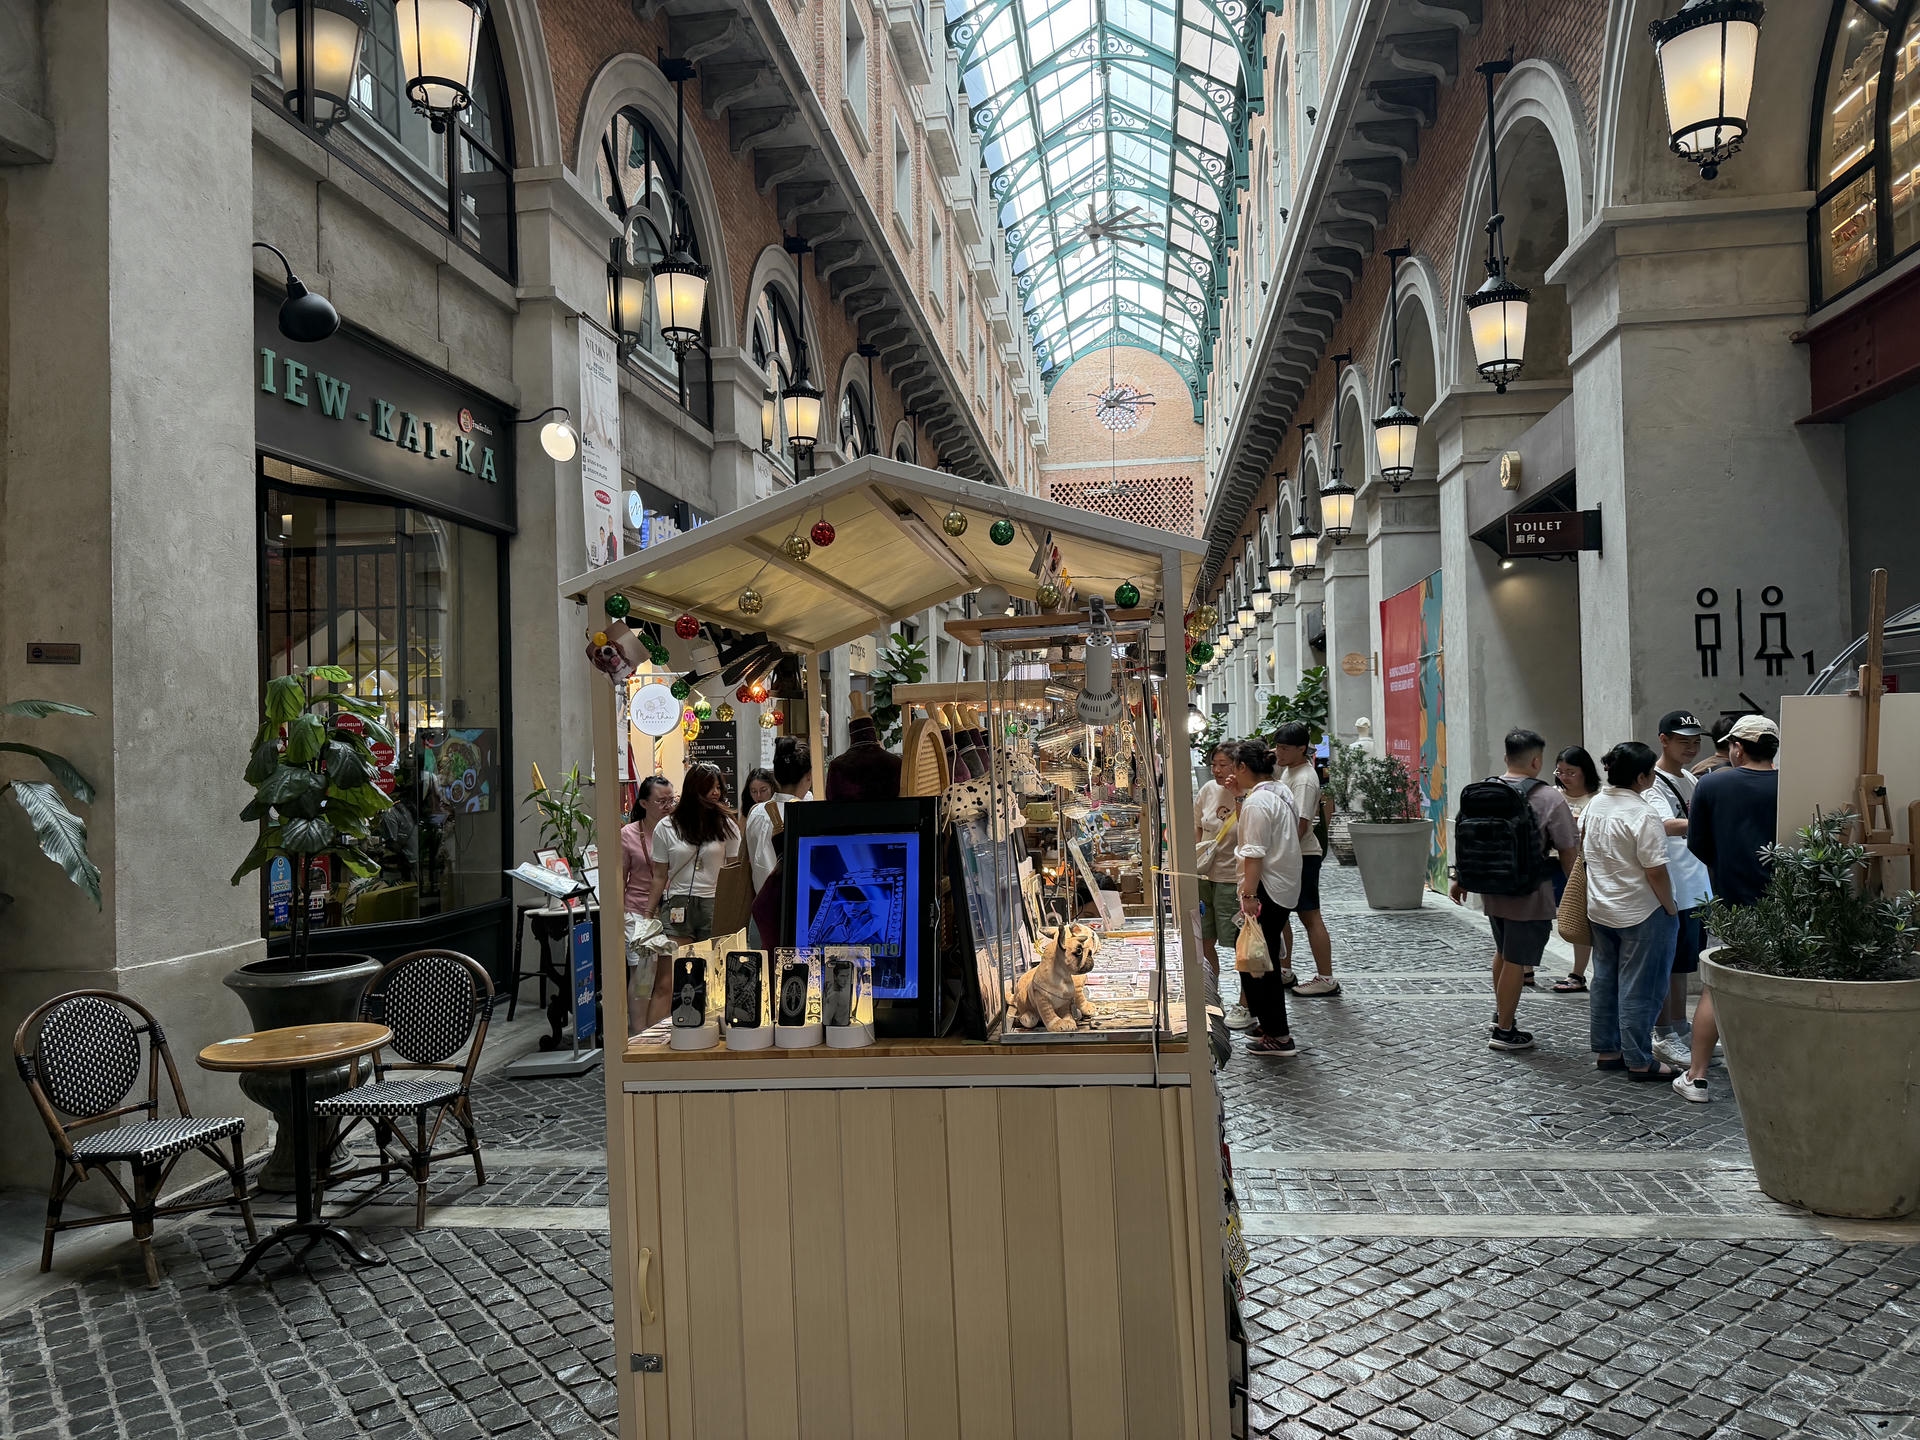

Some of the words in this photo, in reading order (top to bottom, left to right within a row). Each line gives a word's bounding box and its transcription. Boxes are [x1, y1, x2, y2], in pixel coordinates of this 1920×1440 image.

[582, 432, 588, 446] 4
[1514, 520, 1562, 532] TOILET
[1801, 649, 1815, 675] 1
